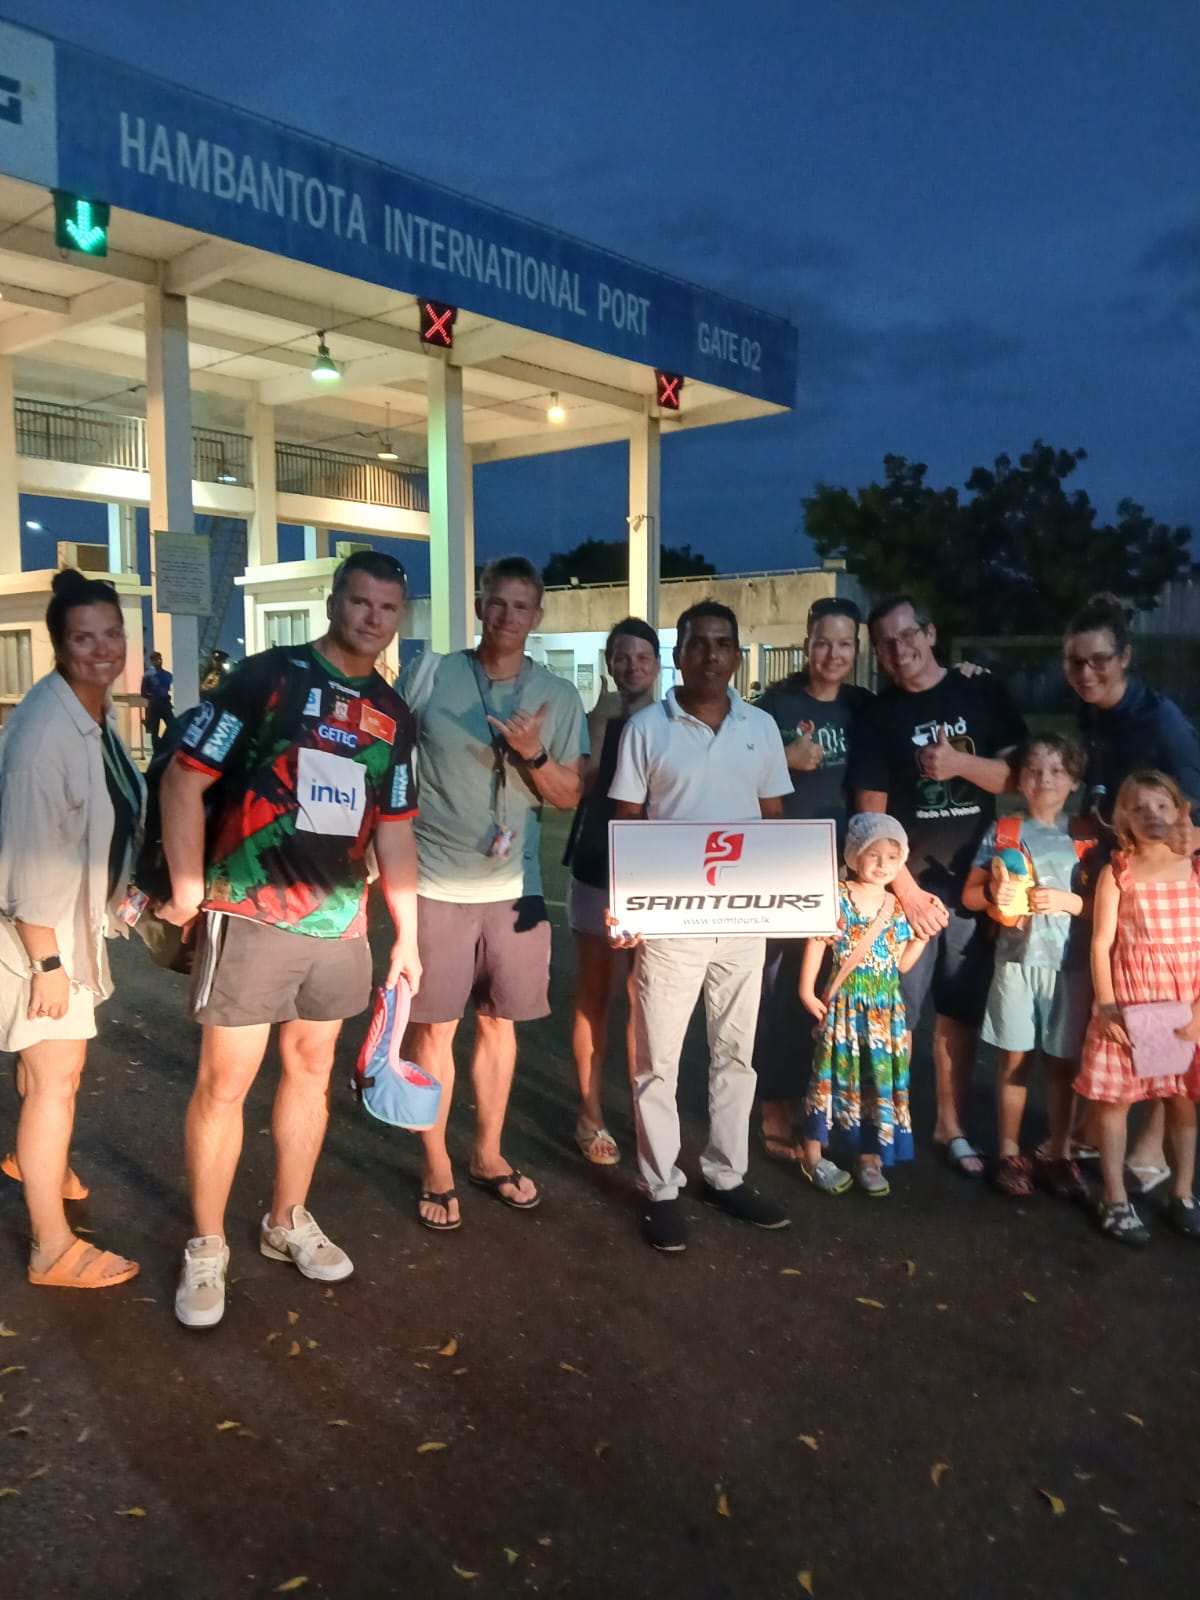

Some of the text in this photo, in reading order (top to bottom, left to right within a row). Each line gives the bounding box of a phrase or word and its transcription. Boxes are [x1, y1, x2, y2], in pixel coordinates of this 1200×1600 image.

[119, 111, 651, 337] HAMBANTOTA INTERNATIONAL PORT
[699, 321, 762, 373] GATE 02
[318, 724, 358, 748] GETEC
[311, 778, 357, 811] intel
[626, 893, 825, 912] SAMTOURS
[683, 915, 771, 925] www.samtours.lk
